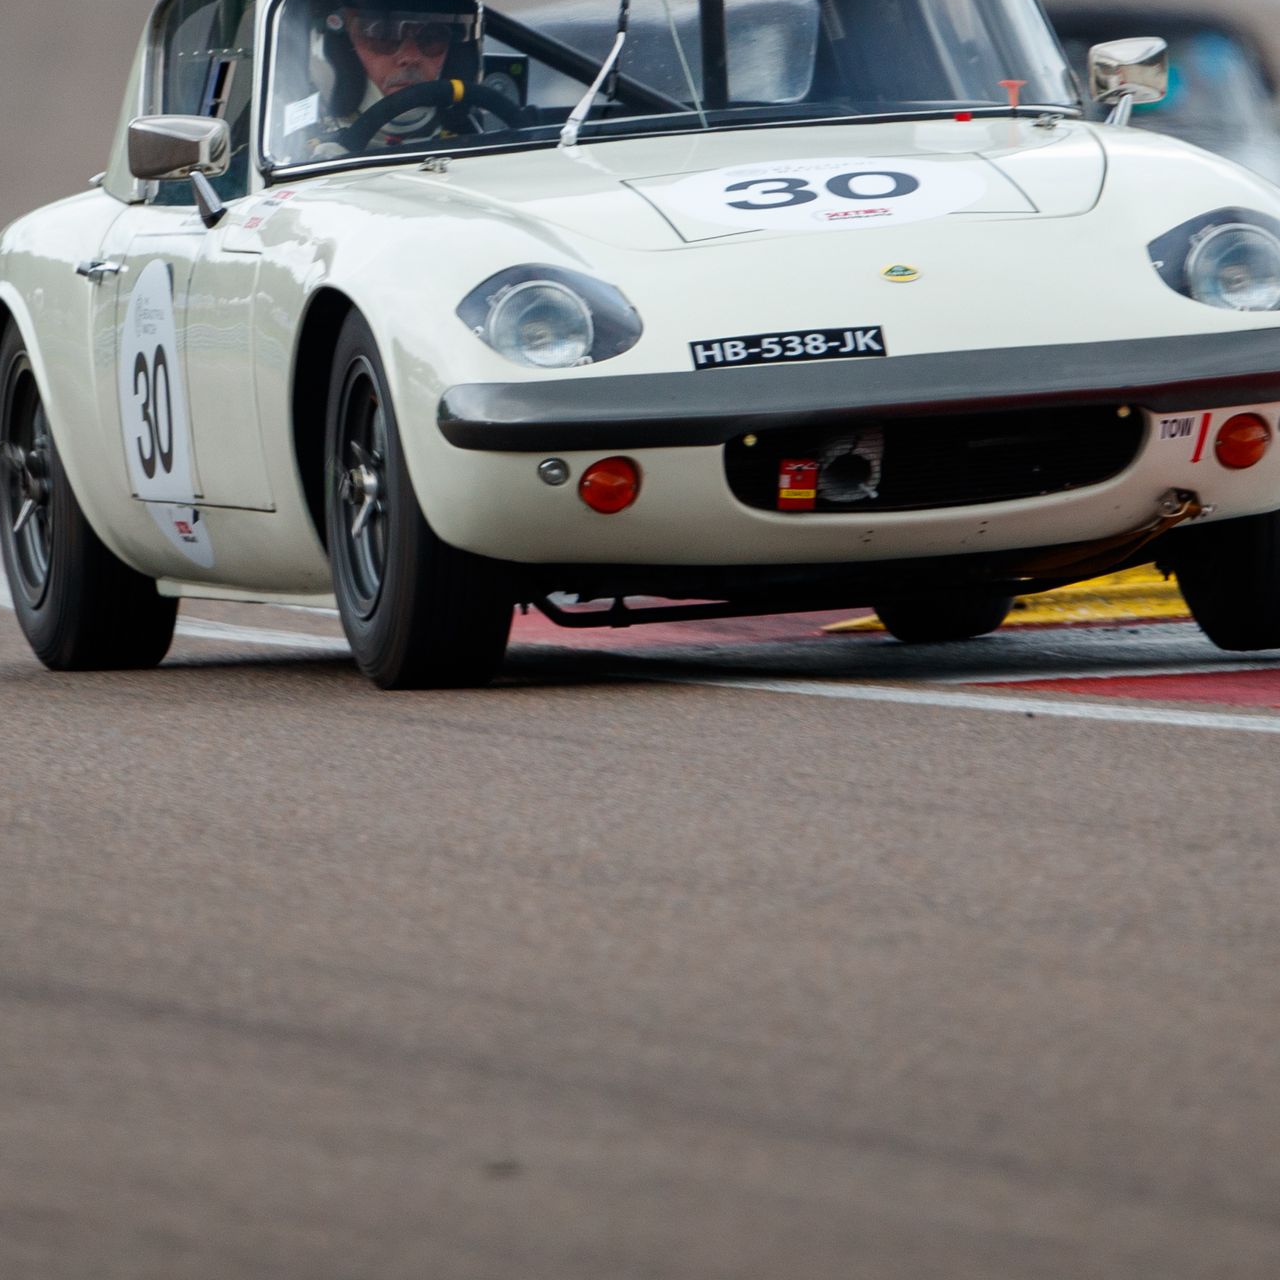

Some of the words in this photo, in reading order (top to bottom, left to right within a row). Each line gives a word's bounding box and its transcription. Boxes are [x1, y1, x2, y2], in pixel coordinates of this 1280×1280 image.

[724, 171, 919, 210] 30
[694, 329, 883, 365] HB-538-JK
[133, 344, 173, 479] 30
[1160, 416, 1196, 439] TOW
